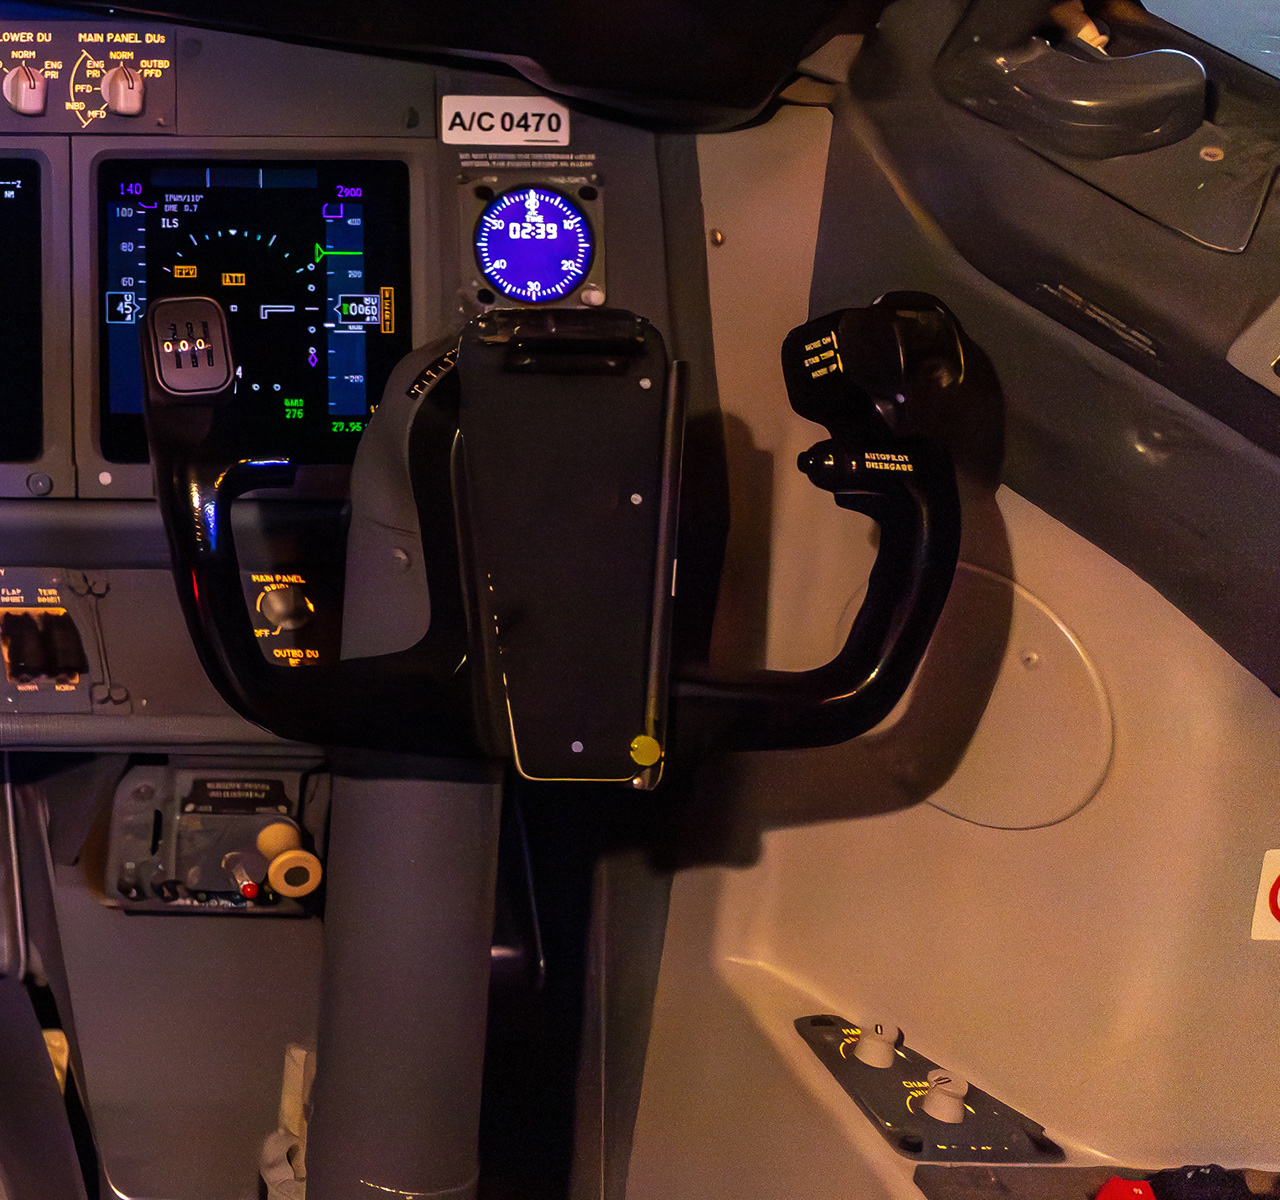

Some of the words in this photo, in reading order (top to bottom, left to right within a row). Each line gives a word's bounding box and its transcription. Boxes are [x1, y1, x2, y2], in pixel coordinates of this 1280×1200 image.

[34, 32, 52, 42] DU
[78, 32, 103, 42] MAIN
[107, 32, 142, 43] PANEL
[146, 33, 165, 43] DUs
[449, 112, 495, 131] A/C
[501, 112, 561, 132] 0470
[120, 183, 142, 195] 140
[336, 186, 362, 198] 2900
[161, 218, 178, 228] ILS
[509, 223, 557, 239] 02:39
